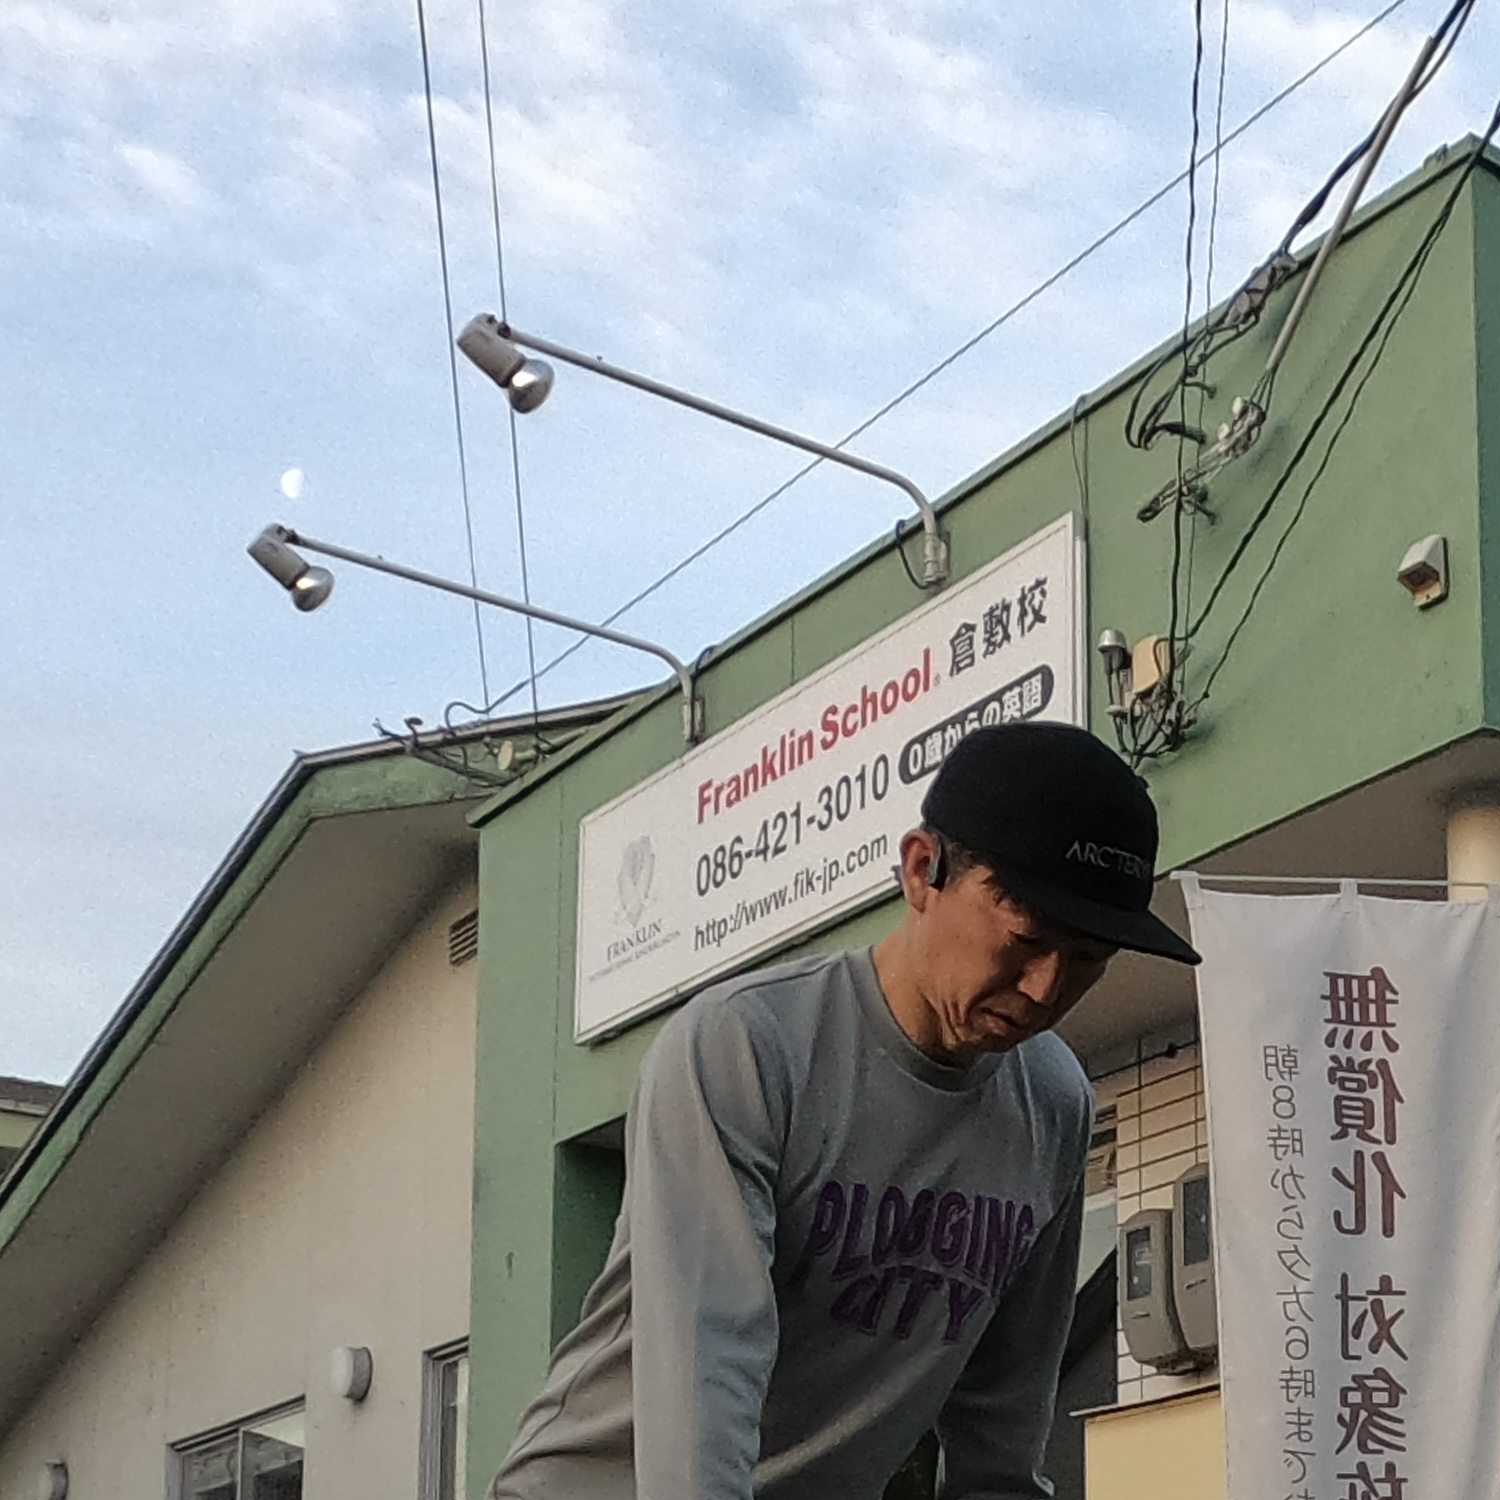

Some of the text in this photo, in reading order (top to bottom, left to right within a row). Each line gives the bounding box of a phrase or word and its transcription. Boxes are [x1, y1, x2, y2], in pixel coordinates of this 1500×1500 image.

[697, 576, 1048, 825] Franklin School 倉敷校
[696, 753, 889, 897] 086-421-3010
